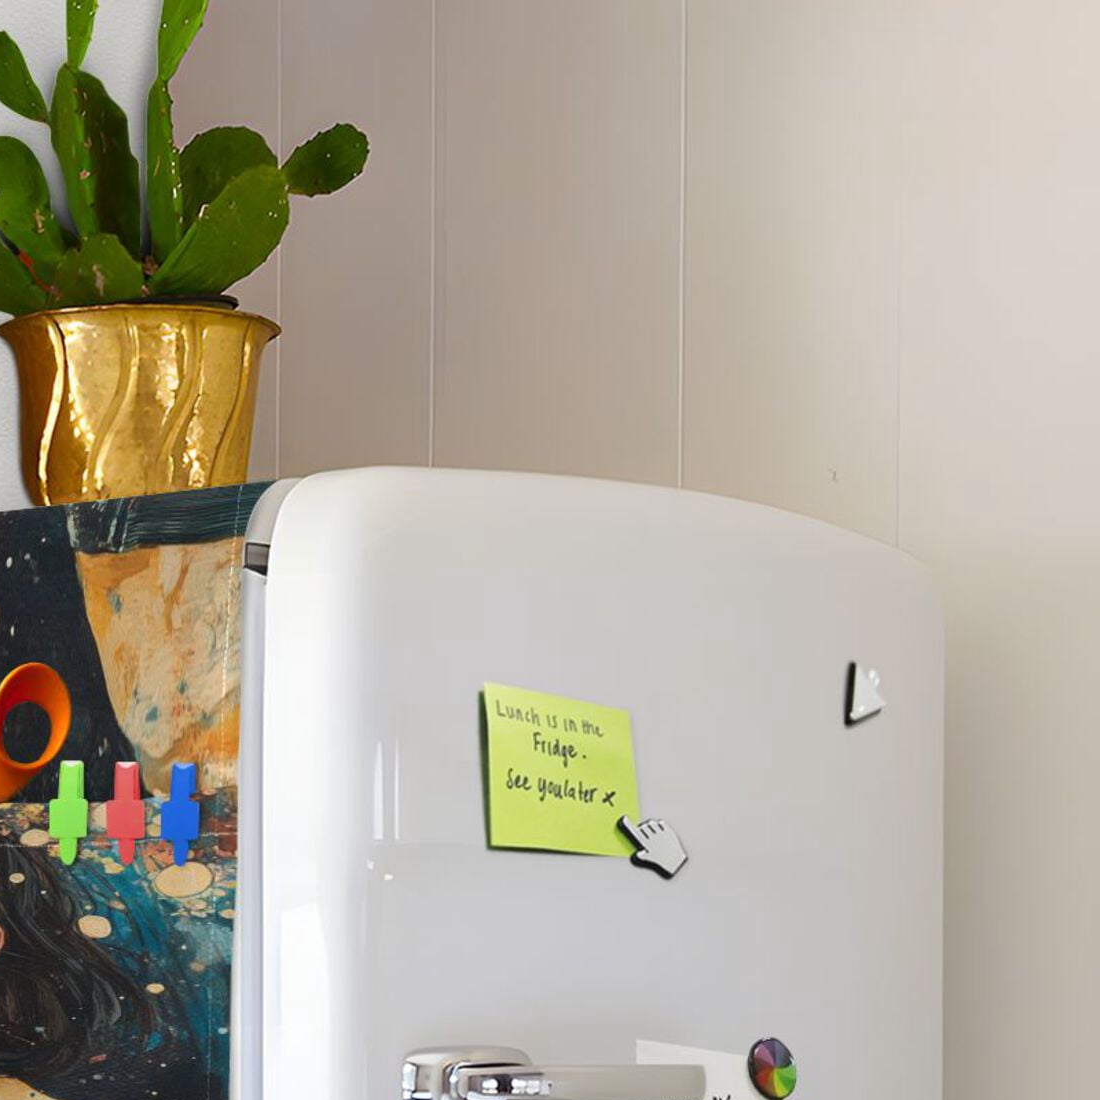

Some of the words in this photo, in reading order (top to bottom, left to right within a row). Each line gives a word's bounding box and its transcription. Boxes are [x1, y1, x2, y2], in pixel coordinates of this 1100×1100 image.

[495, 700, 540, 727] Lunch
[582, 720, 603, 737] the
[506, 768, 532, 791] See
